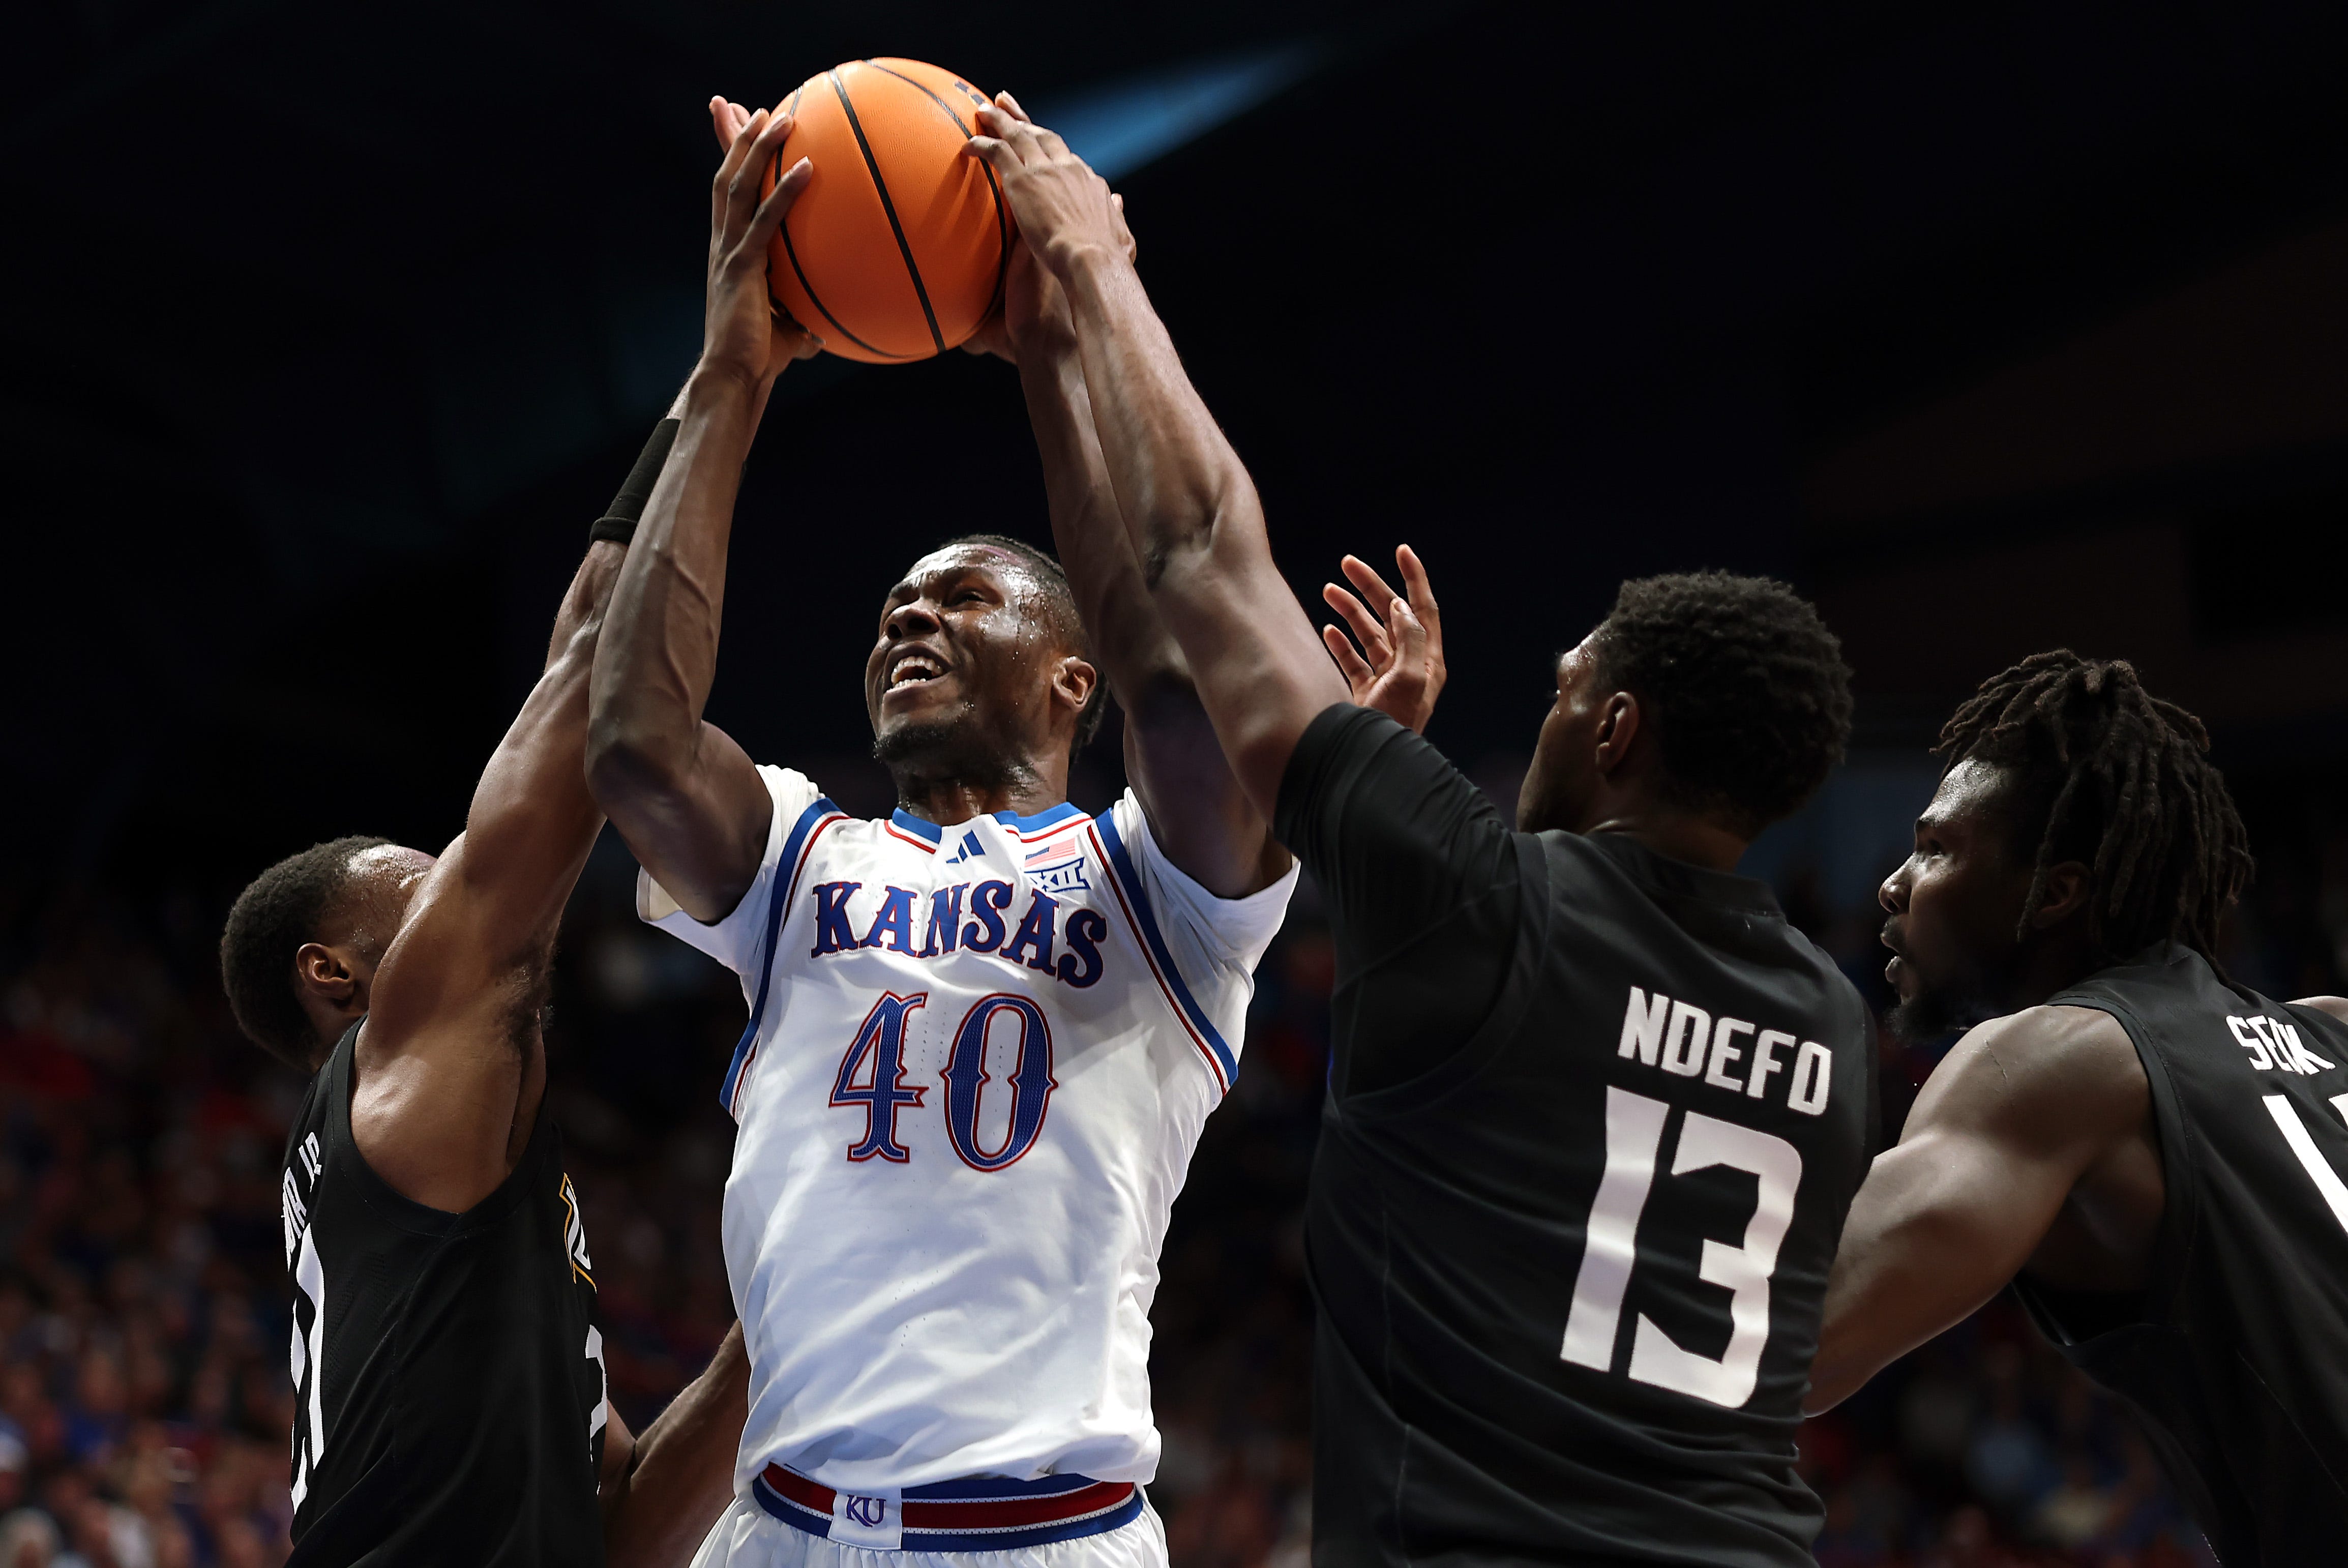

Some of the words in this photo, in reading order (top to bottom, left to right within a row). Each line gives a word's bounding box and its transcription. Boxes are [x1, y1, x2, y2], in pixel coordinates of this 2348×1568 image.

[811, 880, 1108, 989] KANSAS
[828, 990, 1059, 1172] 40
[1617, 986, 1832, 1116] NDEFO
[1560, 1085, 1802, 1409] 13
[846, 1494, 886, 1528] KU
